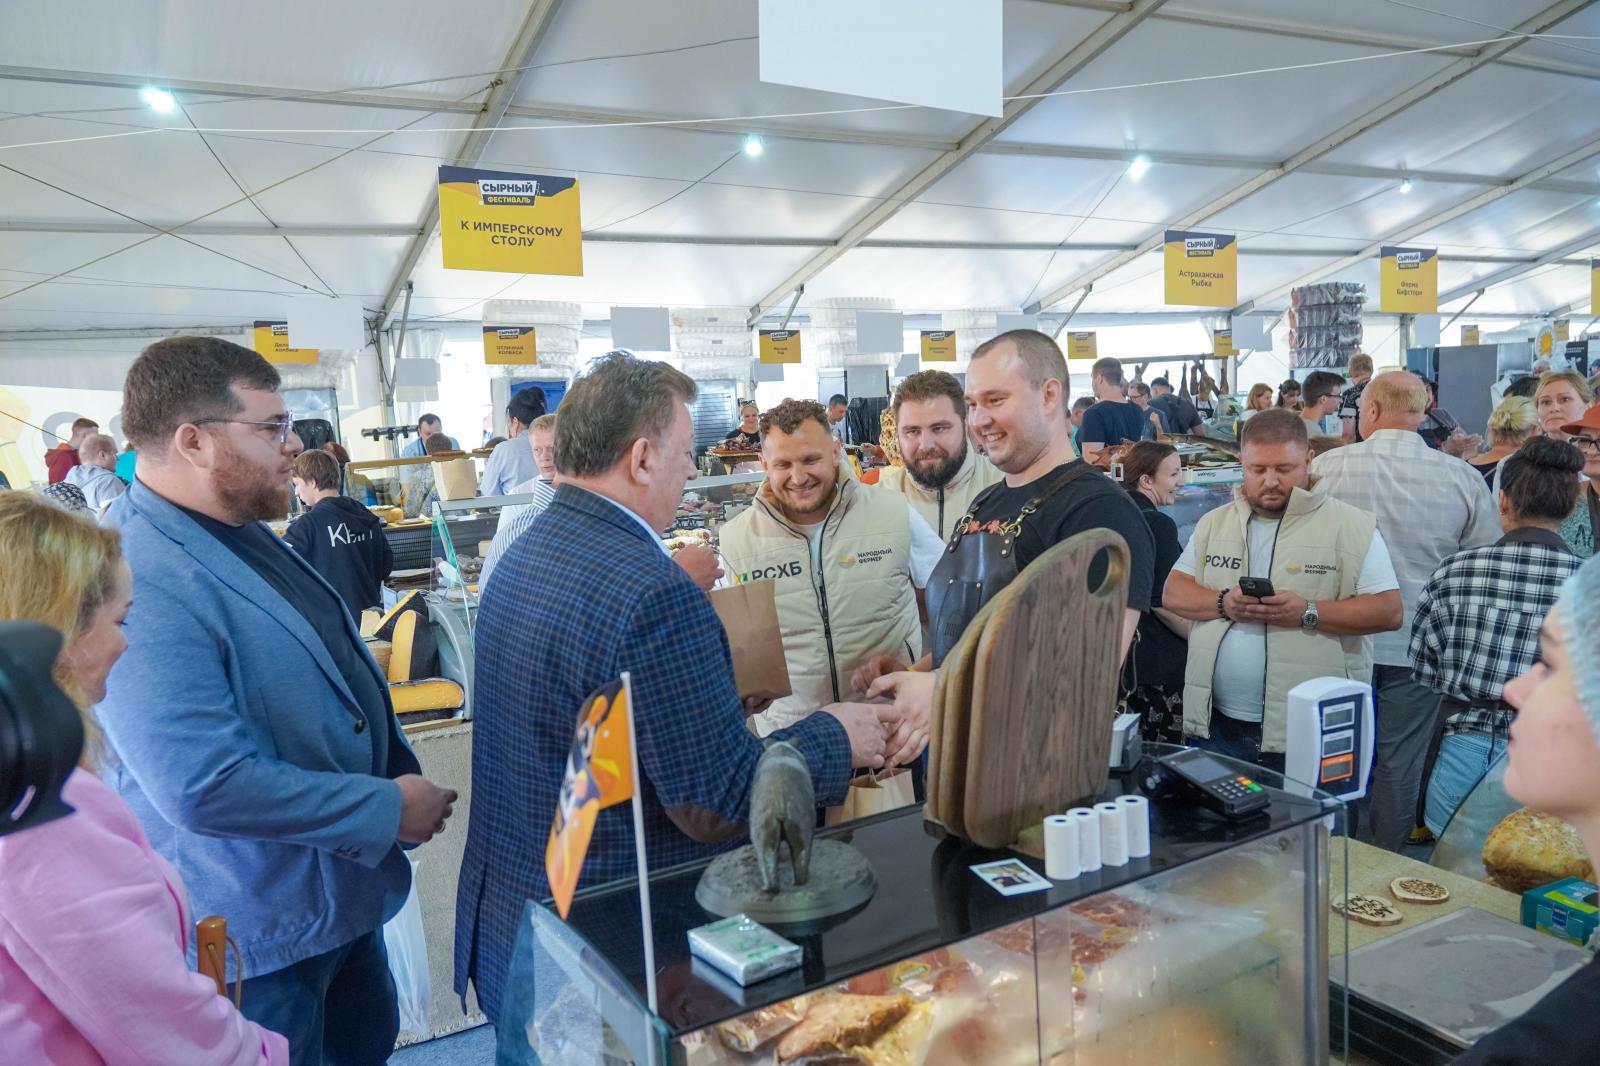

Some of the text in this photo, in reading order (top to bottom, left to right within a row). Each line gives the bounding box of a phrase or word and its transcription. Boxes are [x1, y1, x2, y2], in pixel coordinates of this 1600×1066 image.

[482, 182, 533, 193] СЫРНЫЙ
[487, 196, 531, 204] ФЕСТИВАЛЬ
[461, 220, 563, 237] К ИМПЕРСКОМУ
[491, 235, 535, 247] СТОЛУ
[1186, 239, 1214, 248] СЫРНЫЙ
[1179, 270, 1224, 279] Астраханская
[1191, 279, 1213, 287] Рыбка
[858, 548, 893, 558] НАРОДНЫЙ
[858, 556, 883, 564] ФЕРМЕР
[1205, 554, 1242, 570] РСХБ
[751, 561, 802, 580] РСХБ
